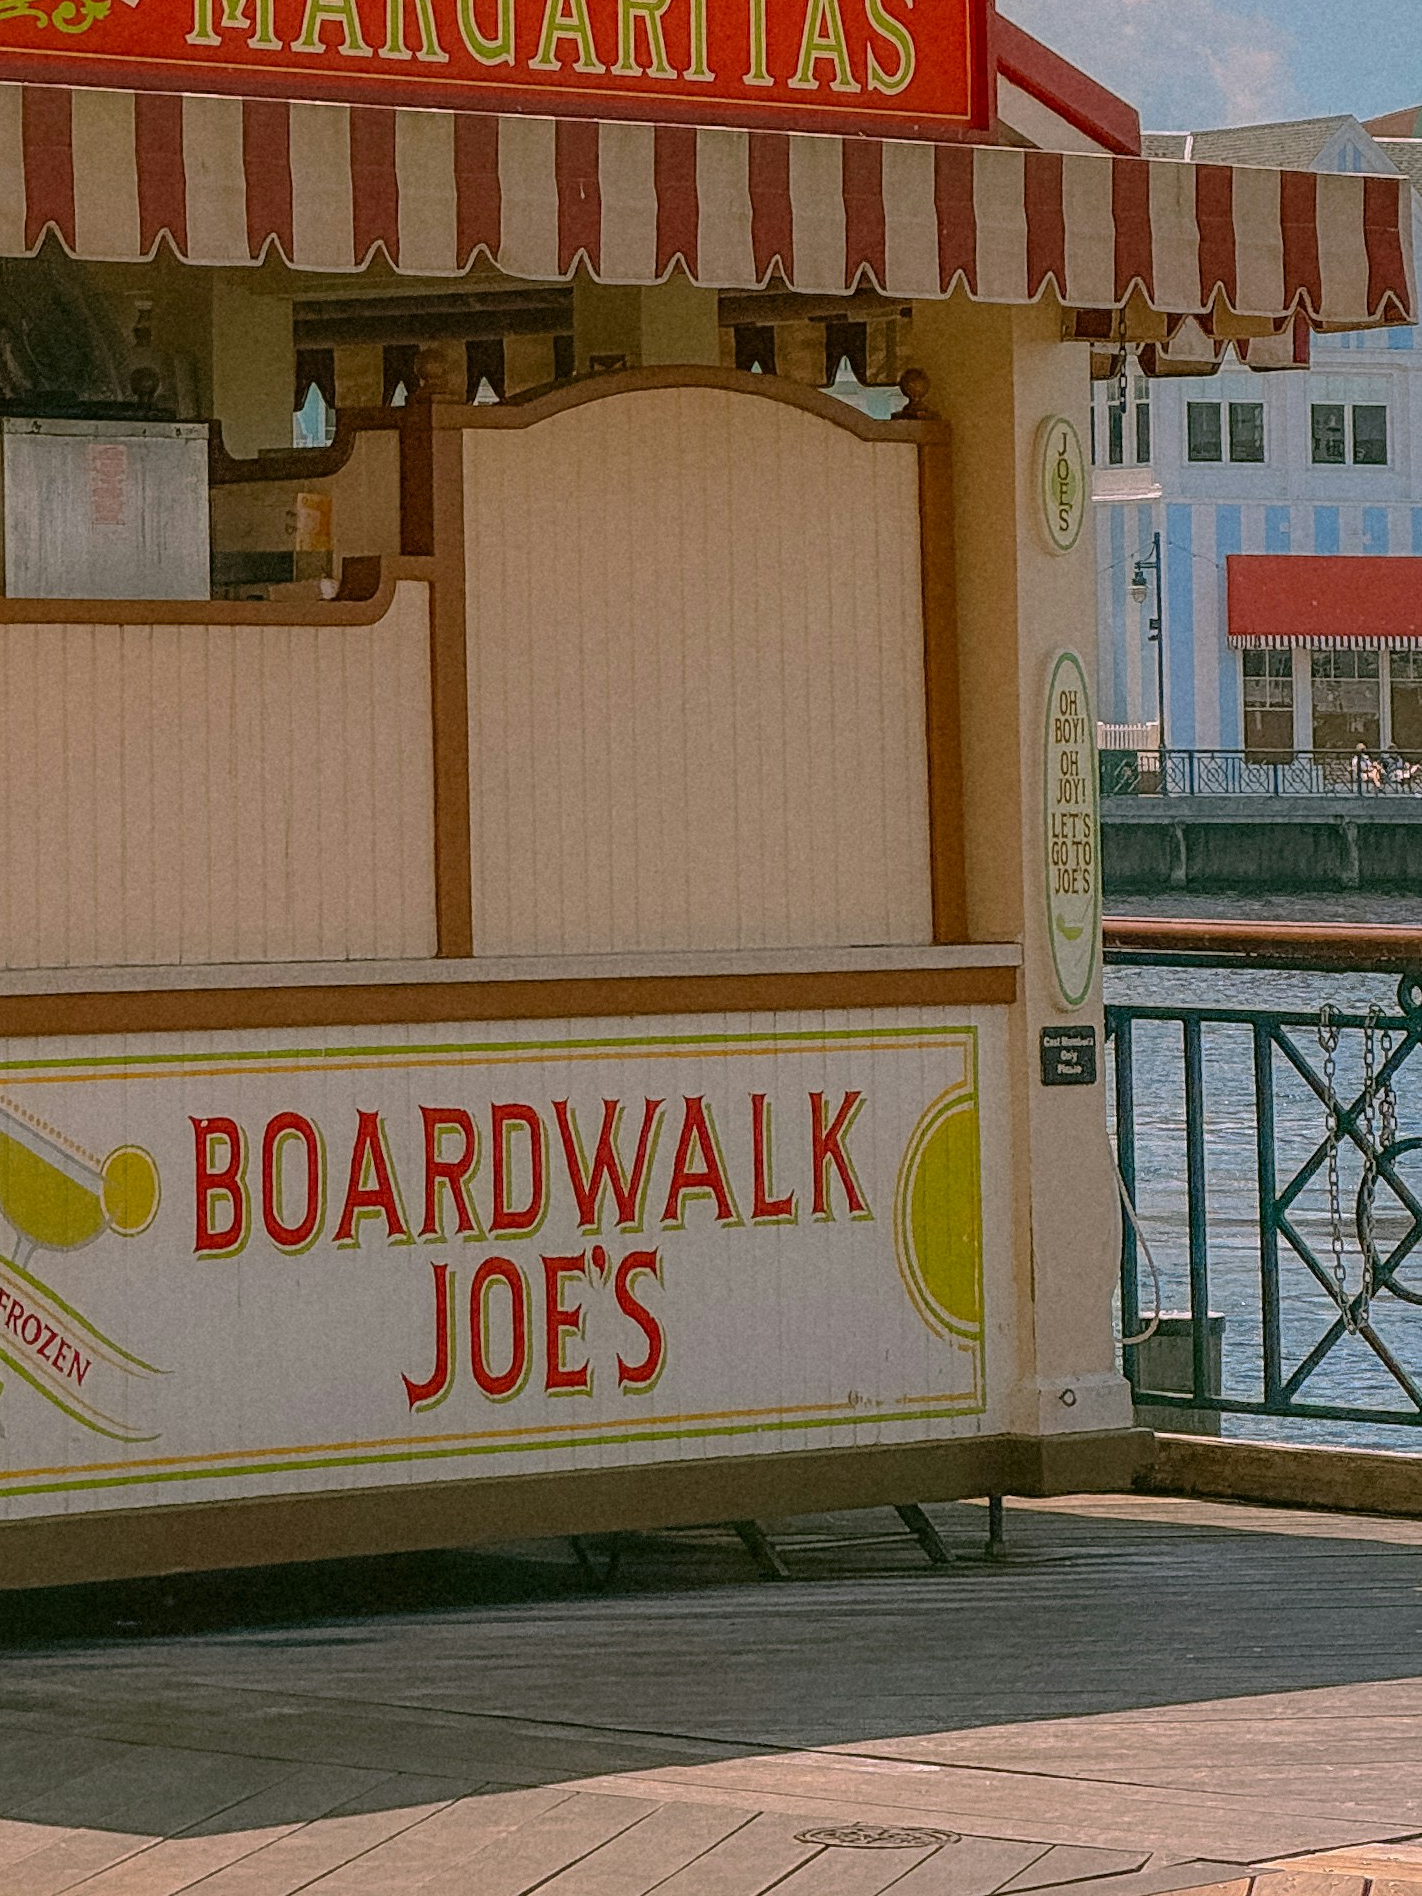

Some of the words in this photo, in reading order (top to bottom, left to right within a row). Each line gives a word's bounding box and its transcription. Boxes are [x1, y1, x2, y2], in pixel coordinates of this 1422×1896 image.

[1058, 432, 1073, 531] JOE'S
[1059, 690, 1078, 716] OH
[1054, 718, 1085, 744] BOY!
[1060, 751, 1079, 776] OH
[1057, 778, 1086, 804] JOY!
[1052, 812, 1091, 839] LET'S
[1052, 841, 1068, 866] GO
[1072, 841, 1091, 866] TO
[1055, 867, 1090, 894] JOE'S
[188, 1090, 875, 1261] BOARDWALK
[401, 1245, 668, 1414] JOE'S
